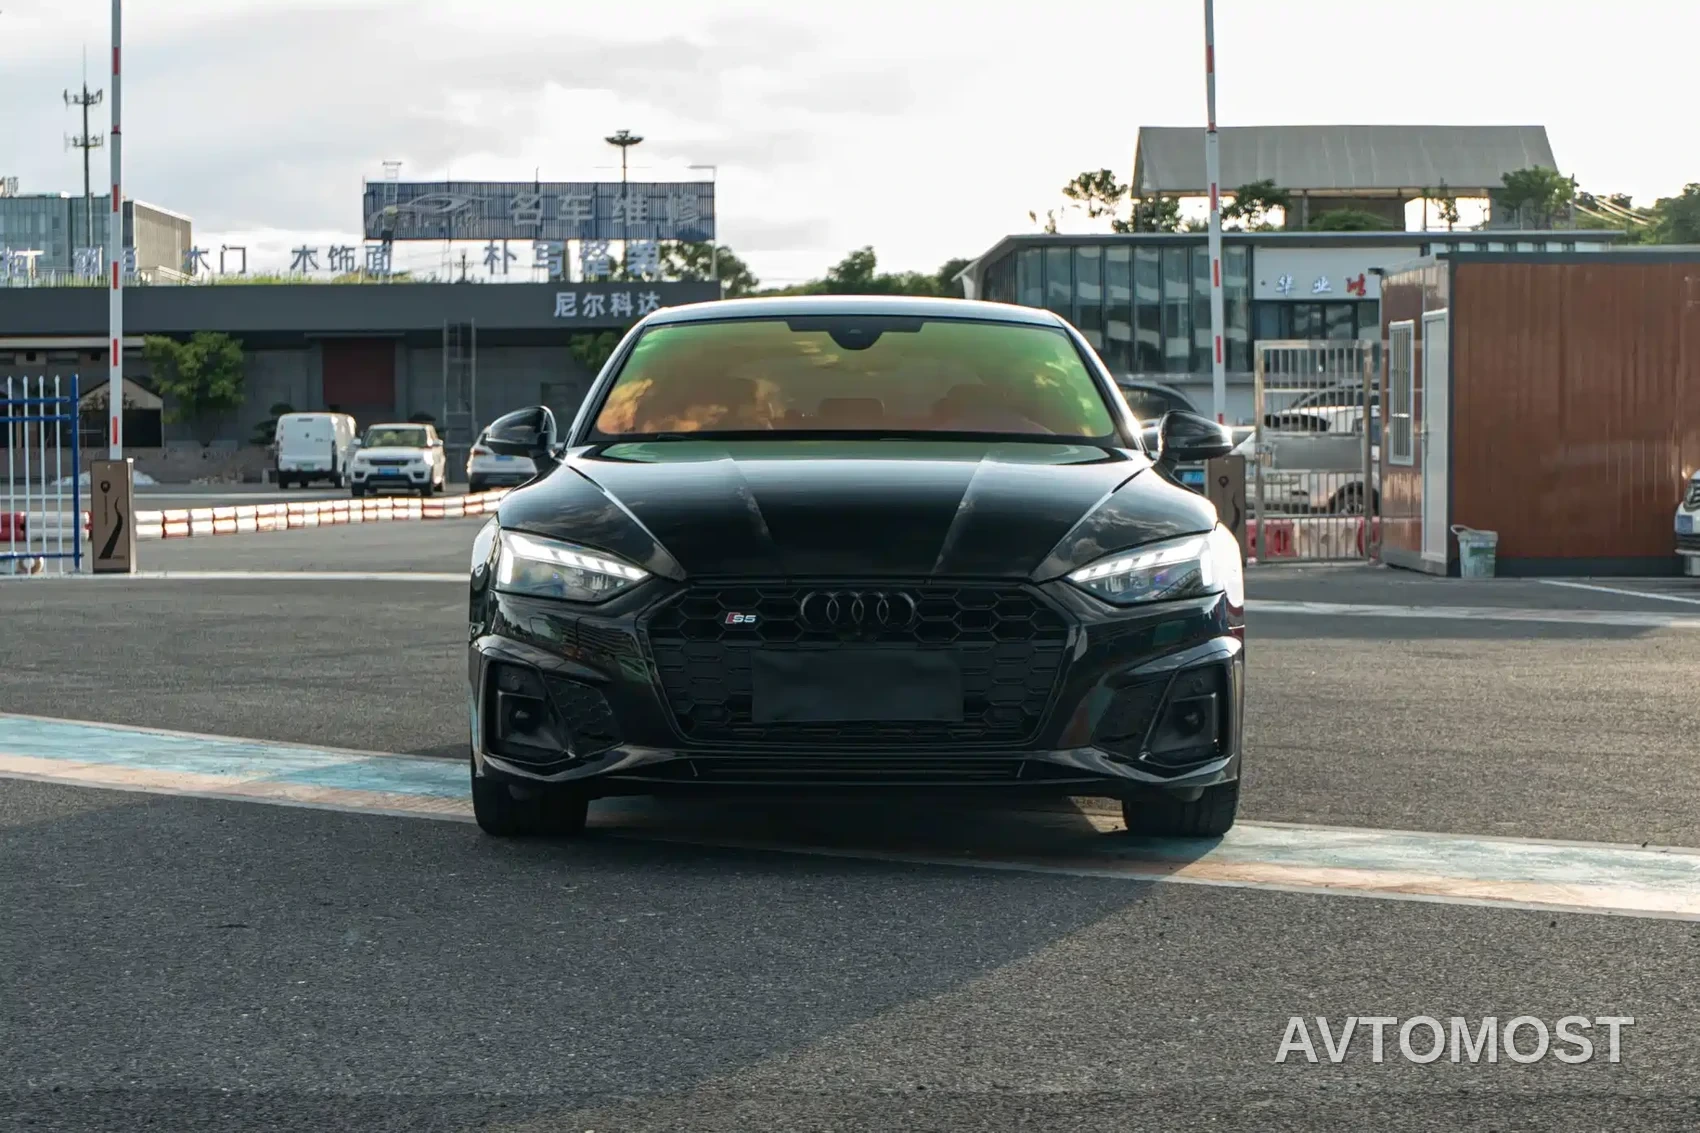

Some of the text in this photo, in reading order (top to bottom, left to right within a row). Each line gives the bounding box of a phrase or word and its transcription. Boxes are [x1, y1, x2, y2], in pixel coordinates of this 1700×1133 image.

[509, 189, 701, 228] 名车维修
[184, 244, 393, 275] 木门 木饰面
[553, 290, 661, 318] 尼尔科达
[731, 614, 757, 623] S5
